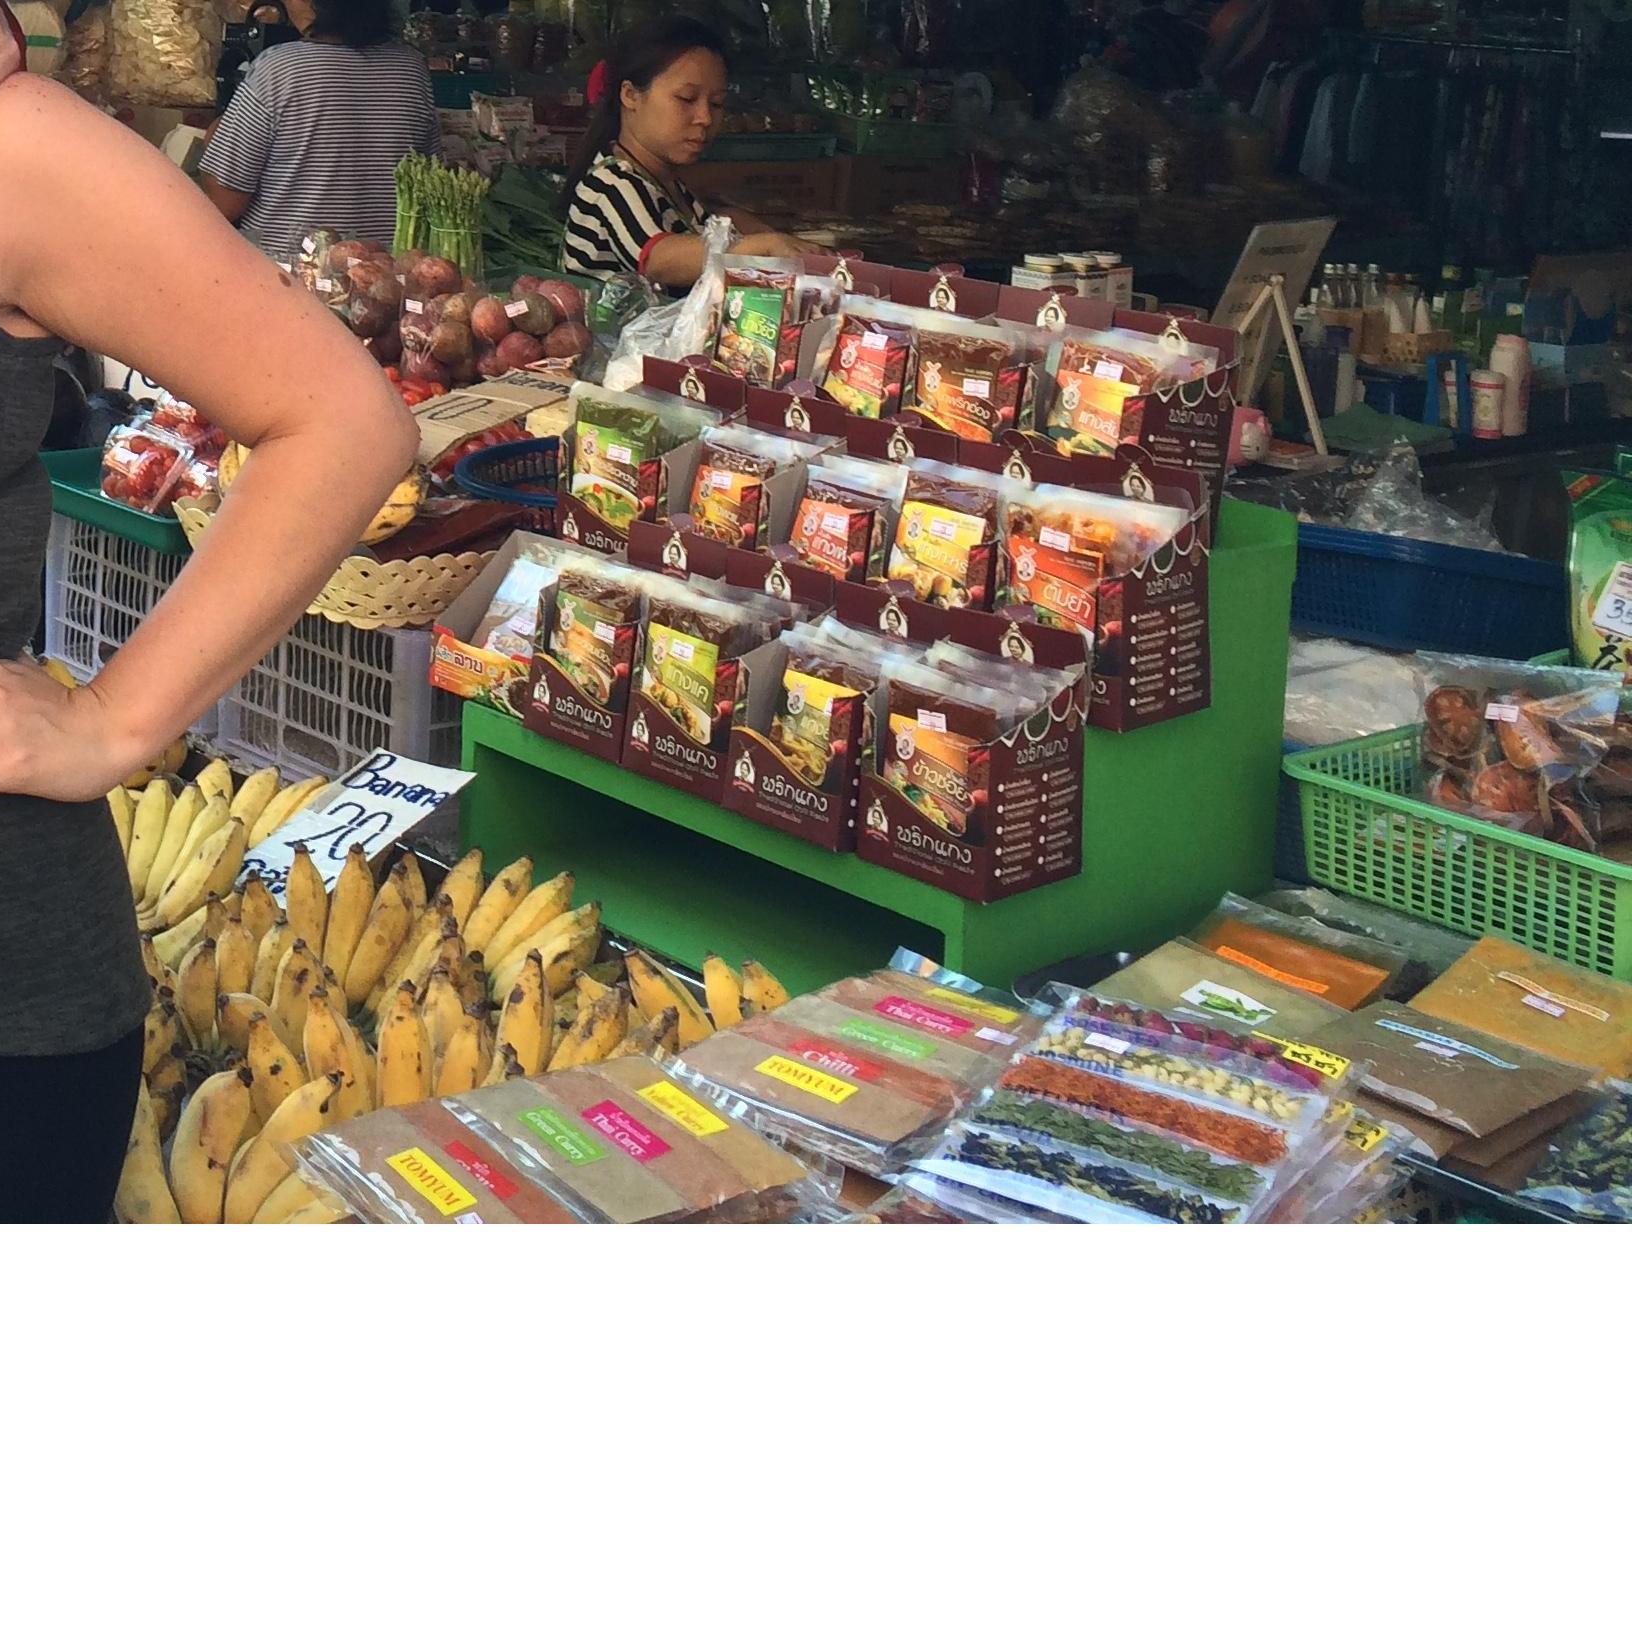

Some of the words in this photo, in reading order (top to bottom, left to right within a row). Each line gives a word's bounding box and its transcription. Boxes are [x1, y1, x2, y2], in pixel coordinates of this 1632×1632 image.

[1042, 581, 1092, 618] ต้มยำ
[555, 695, 613, 729] พริกแกง
[655, 735, 717, 770] พริกแกง
[1015, 737, 1069, 765] พริกแกง
[341, 752, 451, 808] Banana
[762, 775, 829, 812] พริกแกง
[912, 759, 968, 802] ข้าวซอย
[283, 801, 394, 861] 20
[896, 824, 973, 864] พริกแกง
[884, 1004, 913, 1020] Thai
[916, 1016, 953, 1034] Curry
[841, 1025, 879, 1043] Green
[881, 1039, 918, 1058] Curry
[768, 1060, 845, 1096] TOMYUM
[802, 1050, 861, 1076] Chilli
[526, 1111, 556, 1136] Green
[554, 1135, 586, 1160] Curry
[591, 1112, 616, 1135] Thai
[614, 1131, 648, 1158] Curry
[399, 1154, 461, 1206] TOMYUM
